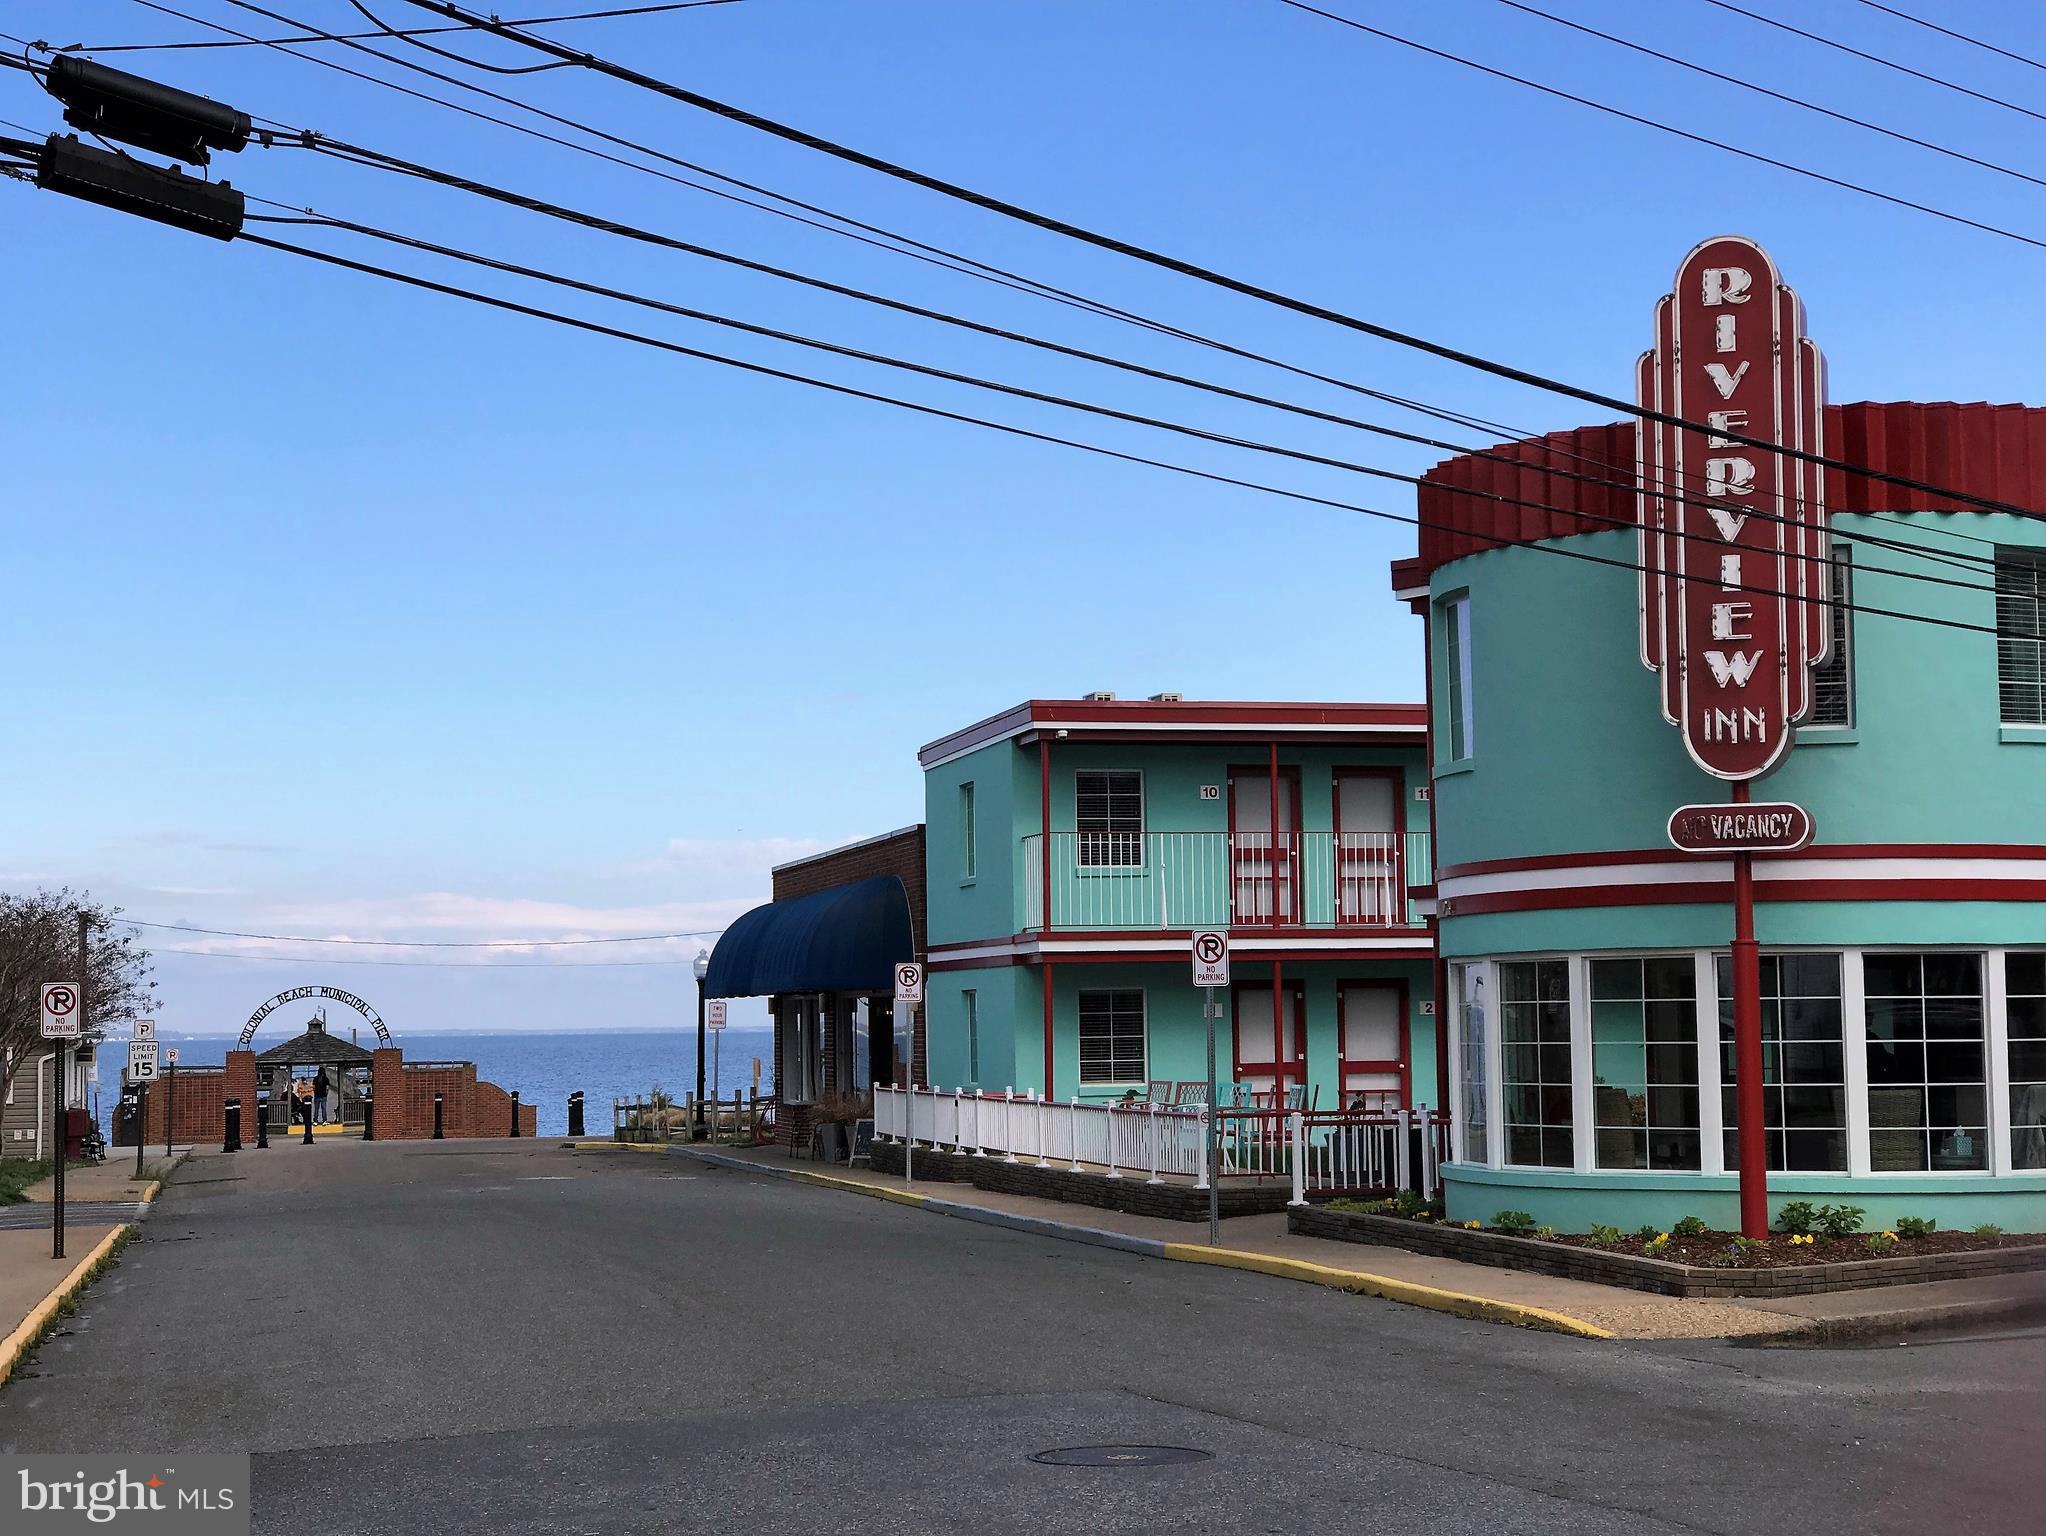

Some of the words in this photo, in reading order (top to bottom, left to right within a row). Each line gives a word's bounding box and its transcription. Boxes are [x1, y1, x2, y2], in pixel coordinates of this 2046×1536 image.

[1702, 266, 1764, 689] RIVERVIEW
[1703, 706, 1766, 744] INN
[1202, 786, 1218, 798] 10
[1710, 813, 1793, 840] VACANCY
[1206, 966, 1216, 974] NO
[1197, 973, 1225, 982] PARKING
[1425, 1002, 1433, 1014] 2
[55, 1017, 66, 1025] NO
[239, 1002, 275, 1045] COLONIAL
[276, 986, 313, 1005] BEACH
[320, 986, 371, 1018] MUNICIPAL
[371, 1016, 390, 1042] PIER
[45, 1024, 76, 1033] PARKING
[130, 1044, 157, 1052] SPEED
[133, 1061, 153, 1077] 15
